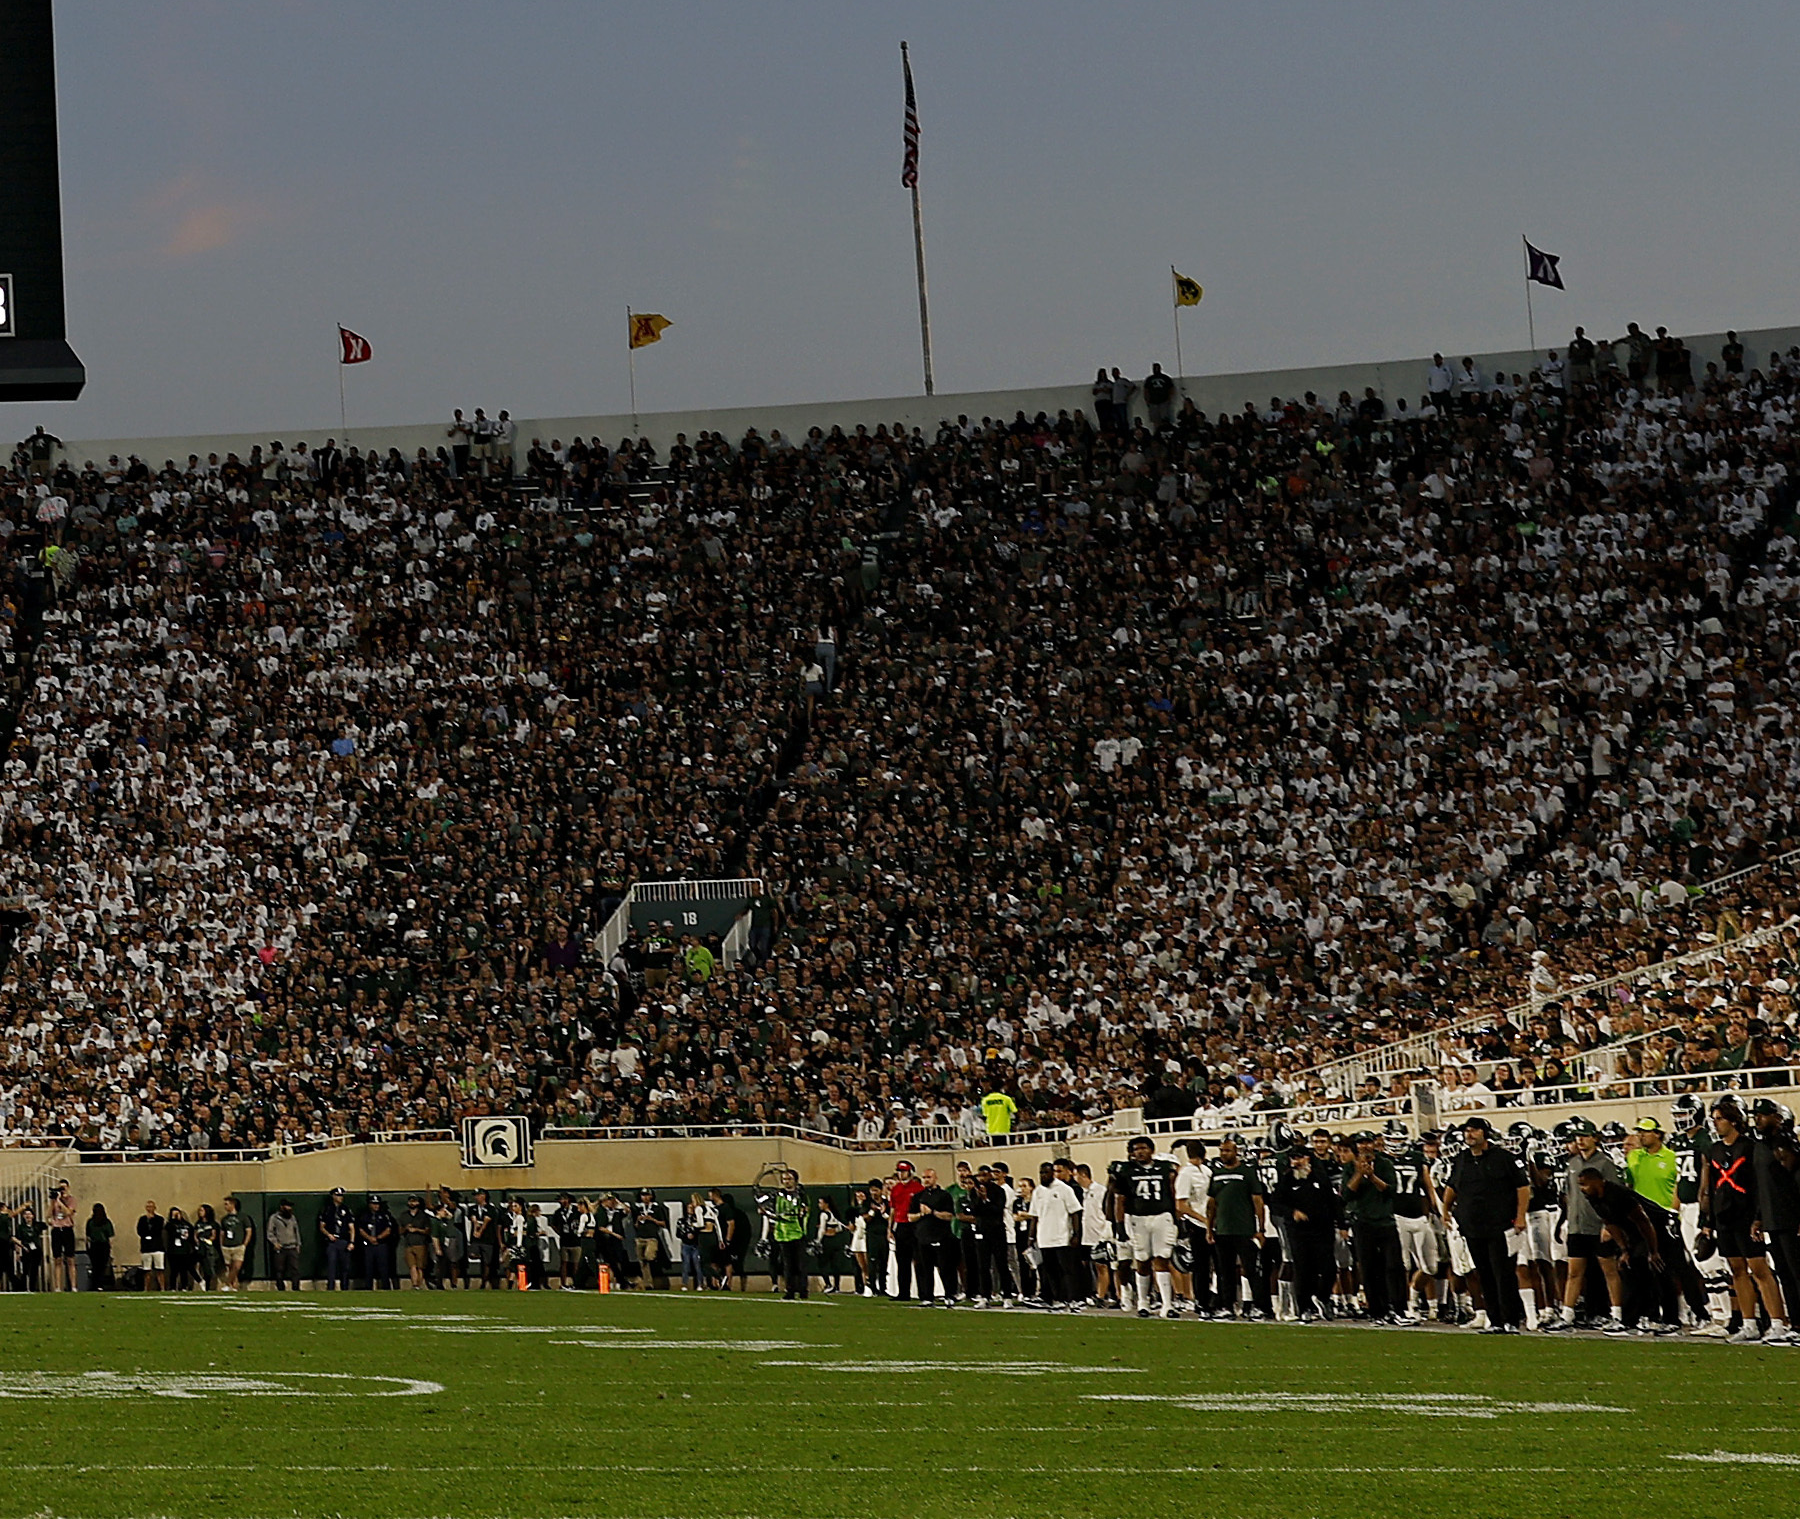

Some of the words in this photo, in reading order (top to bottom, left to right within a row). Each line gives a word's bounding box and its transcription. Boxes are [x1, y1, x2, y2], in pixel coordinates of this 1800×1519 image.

[682, 912, 698, 925] 18
[1136, 1180, 1161, 1200] 41
[1397, 1170, 1418, 1194] 17
